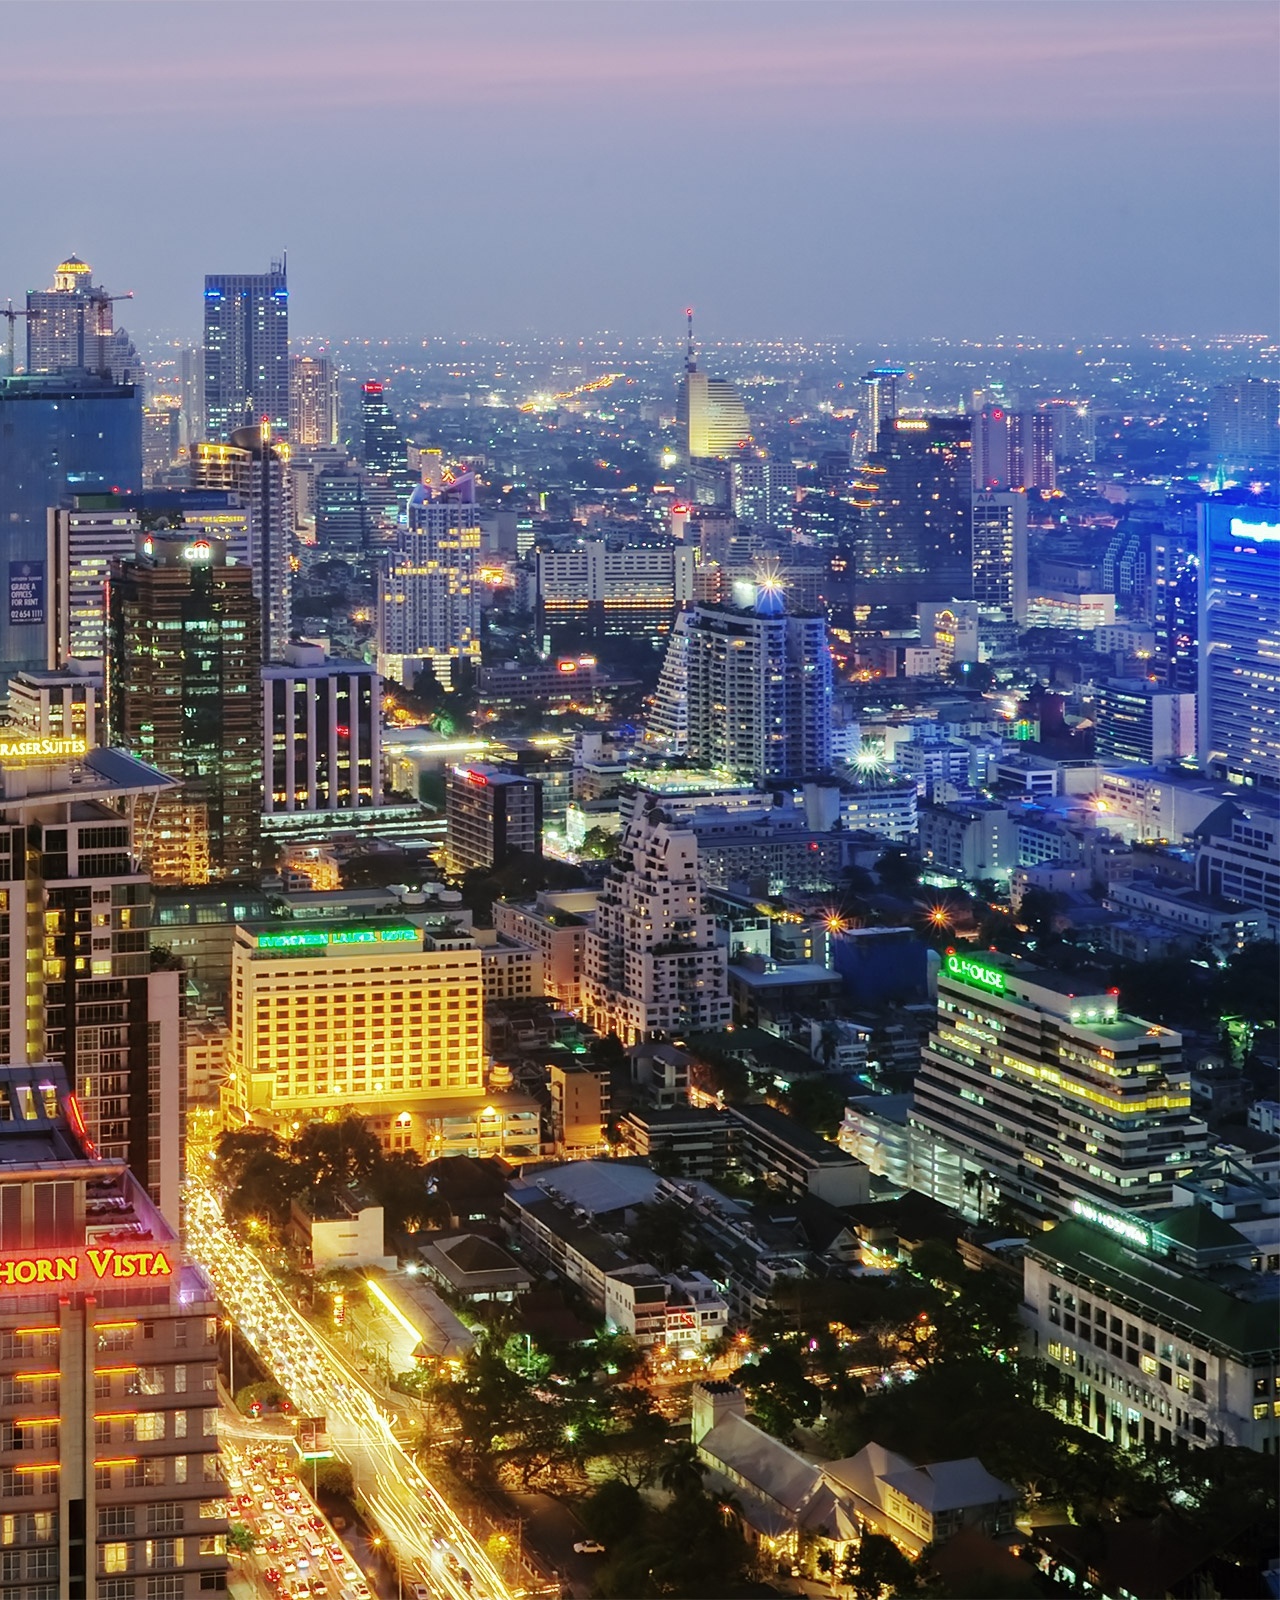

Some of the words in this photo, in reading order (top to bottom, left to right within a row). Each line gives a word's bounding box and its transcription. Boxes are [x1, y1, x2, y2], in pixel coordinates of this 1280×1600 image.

[977, 494, 996, 502] AIA
[184, 542, 210, 559] citi
[11, 583, 30, 591] GRADE
[11, 591, 33, 599] OFFICES
[24, 598, 38, 606] RENT
[11, 610, 19, 618] 02
[19, 610, 31, 618] 654
[32, 609, 43, 617] 1111
[380, 929, 418, 941] HOTEL
[86, 1249, 172, 1278] VISTA
